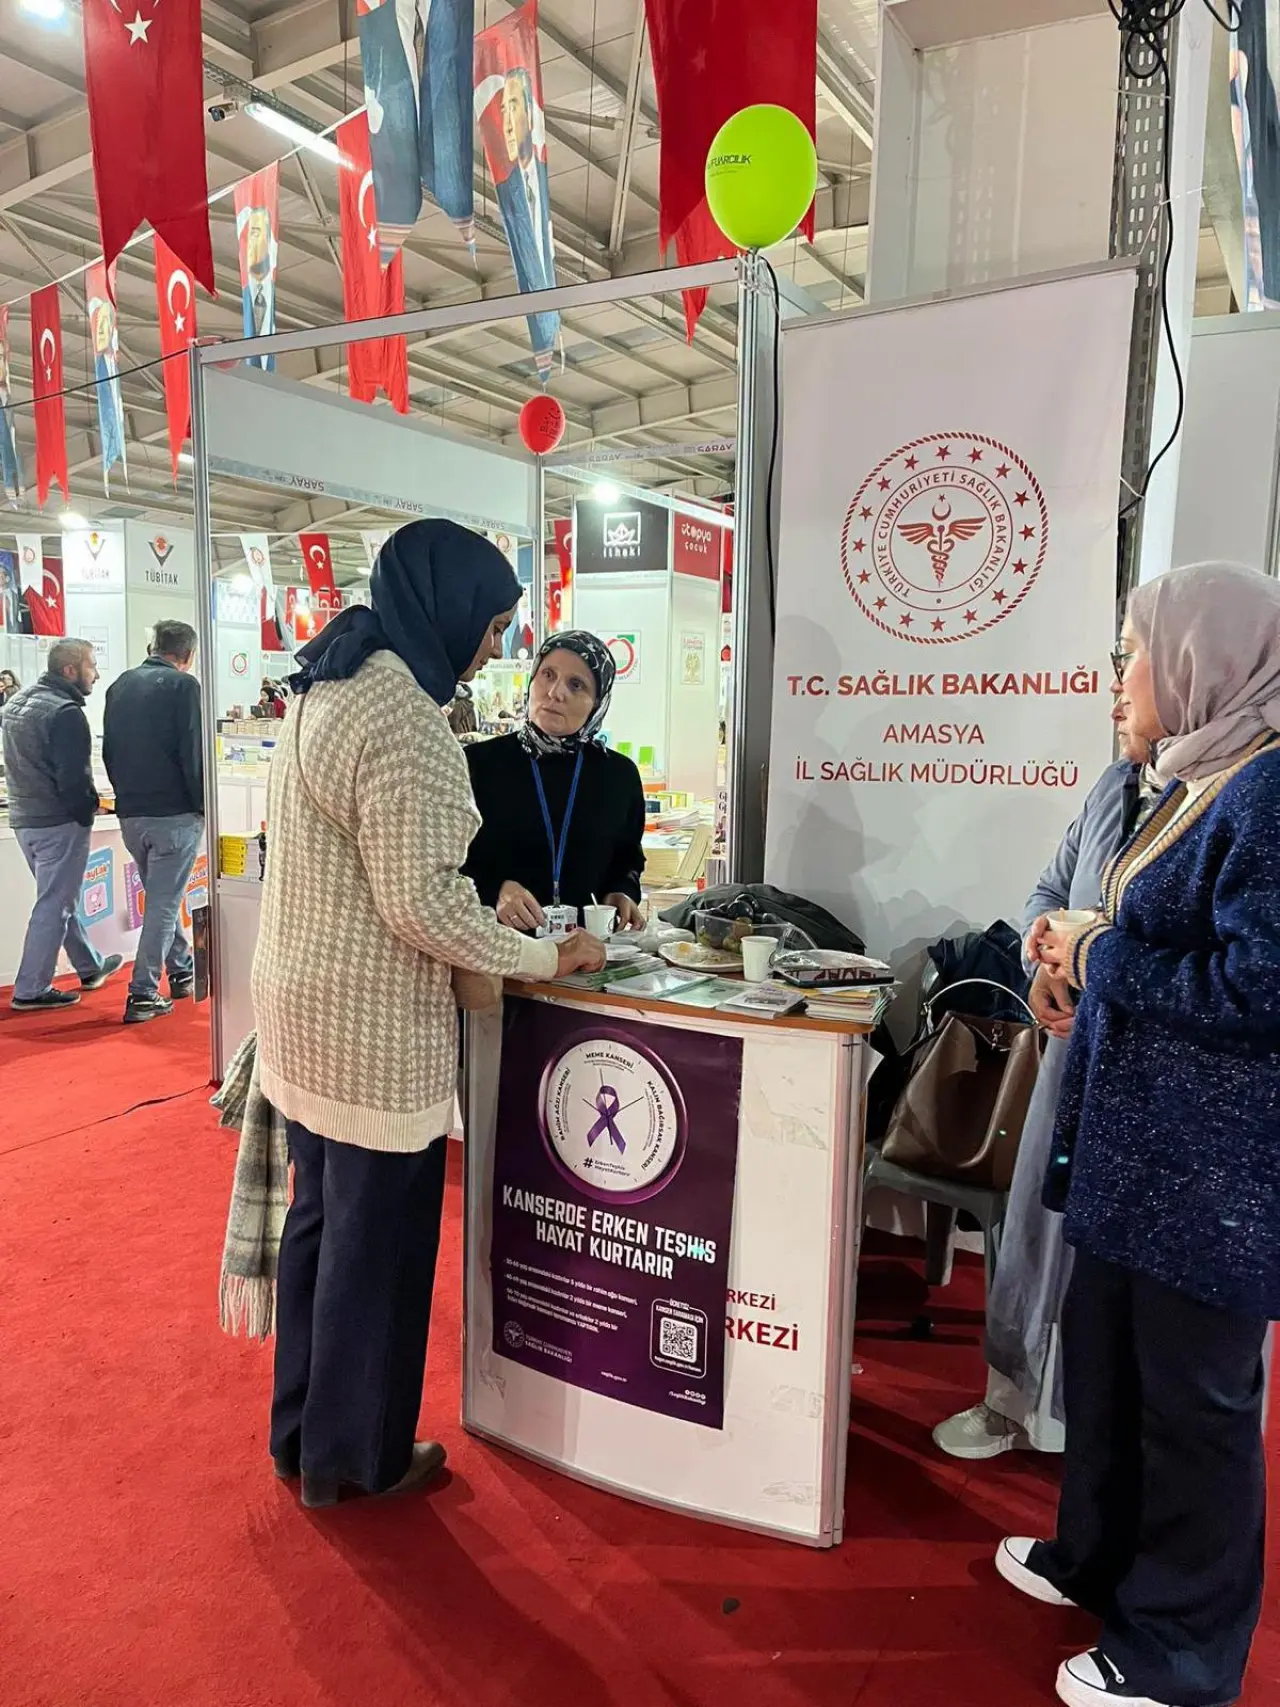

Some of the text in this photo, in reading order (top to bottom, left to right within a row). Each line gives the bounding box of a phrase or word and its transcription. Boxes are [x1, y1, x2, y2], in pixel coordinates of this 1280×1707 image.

[877, 470, 1007, 598] TÜRKİYE CUMHURİYETİ SAĞLIK BAKANLIĞI
[145, 570, 179, 585] TÜBİTAK
[787, 665, 1099, 696] T.C. SAĞLIK BAKANLIĞI
[883, 724, 985, 745] AMASYA
[795, 756, 1079, 787] İL SAĞLIK MÜDÜRLÜĞÜ
[585, 1051, 605, 1060] MEME
[605, 1052, 635, 1069] KANSERİ
[502, 1184, 588, 1229] KANSERDE
[591, 1209, 649, 1246] ERKEN
[535, 1219, 674, 1280] HAYAT KURTARIR
